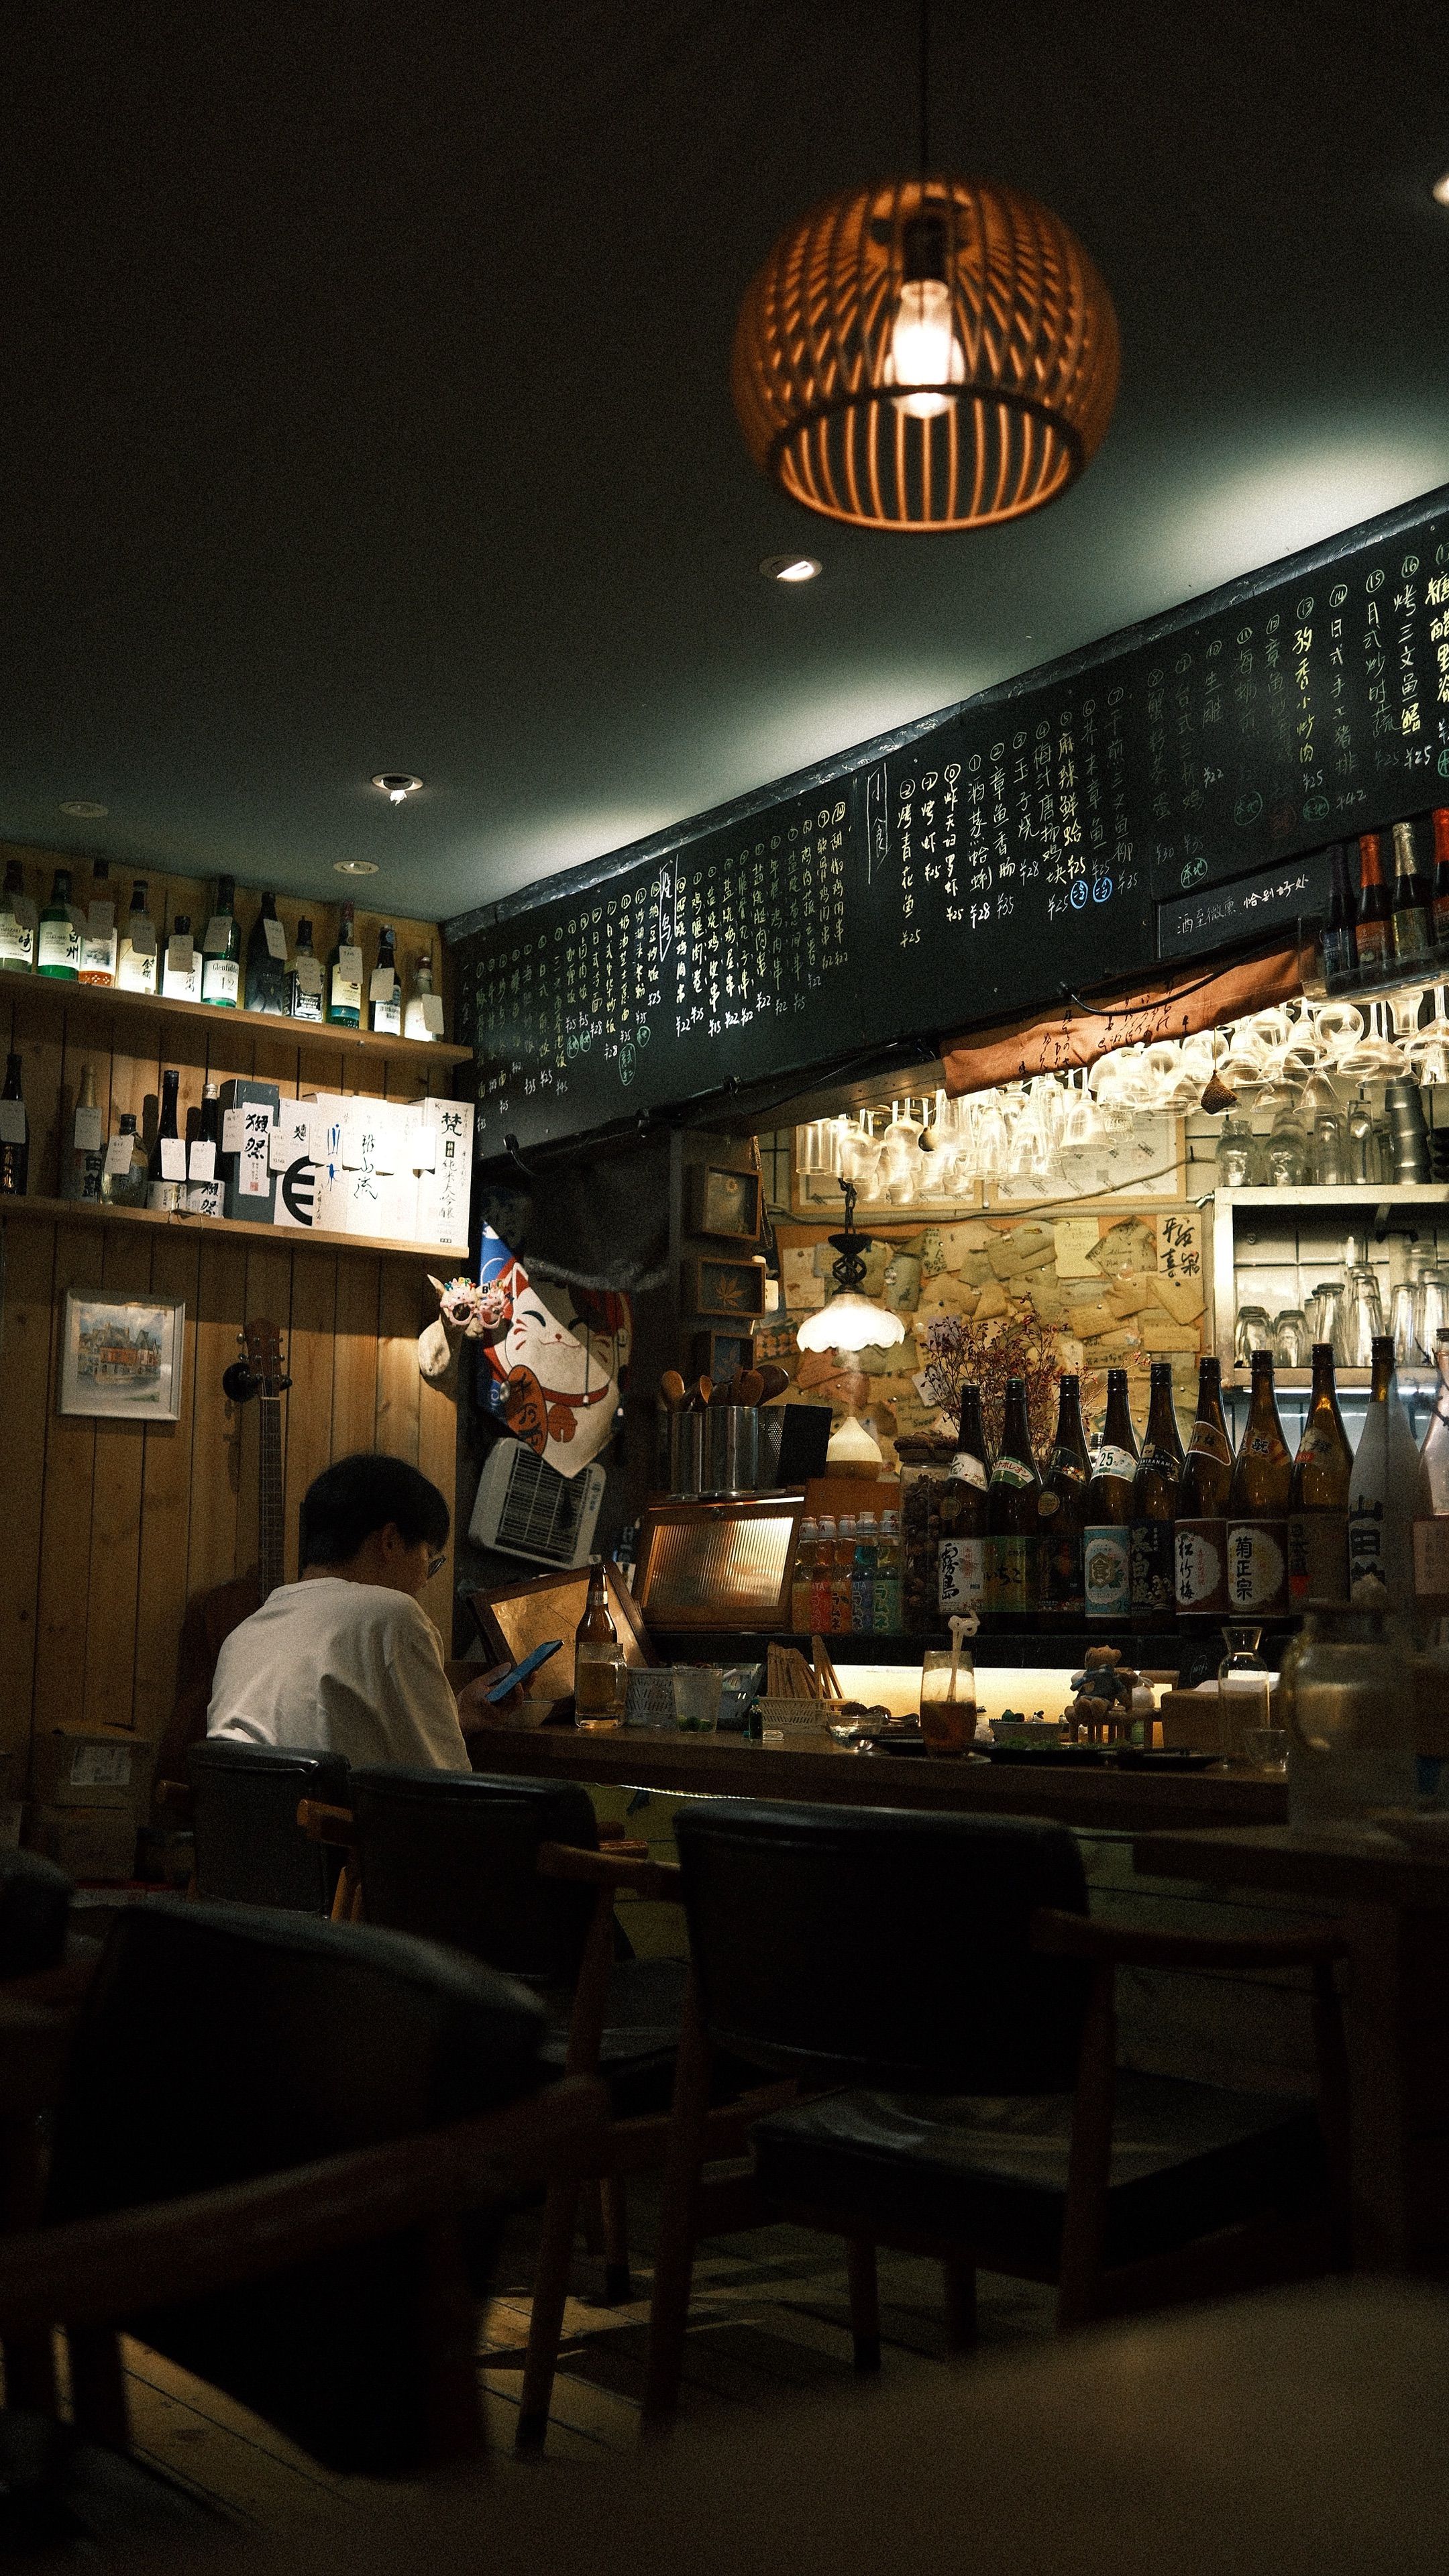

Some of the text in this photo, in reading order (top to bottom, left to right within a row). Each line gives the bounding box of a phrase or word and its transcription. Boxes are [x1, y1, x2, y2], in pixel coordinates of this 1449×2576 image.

[1360, 601, 1401, 738] 日式炒时蔬
[1403, 745, 1432, 769] ¥25
[1057, 731, 1081, 847] 麻辣鲜蛤
[1302, 769, 1324, 792] ¥25
[1013, 757, 1039, 842] 玉子烧
[871, 773, 886, 859] 小食
[920, 800, 936, 853] 烤虾
[989, 765, 1016, 880] 章鱼香肠
[897, 803, 914, 919] 烤青花鱼
[1019, 859, 1040, 886] ¥28
[1067, 855, 1085, 880] ¥25
[944, 906, 964, 922] ¥25
[970, 902, 990, 929] ¥28
[1047, 894, 1069, 922] ¥25
[900, 928, 922, 949] ¥25
[221, 977, 235, 991] 12
[755, 991, 771, 1012] ¥22
[775, 998, 788, 1017] ¥22
[676, 1015, 691, 1038] ¥22
[1099, 1452, 1115, 1468] 25
[1179, 1541, 1195, 1601] 松竹梅
[1235, 1536, 1253, 1601] 菊正宗
